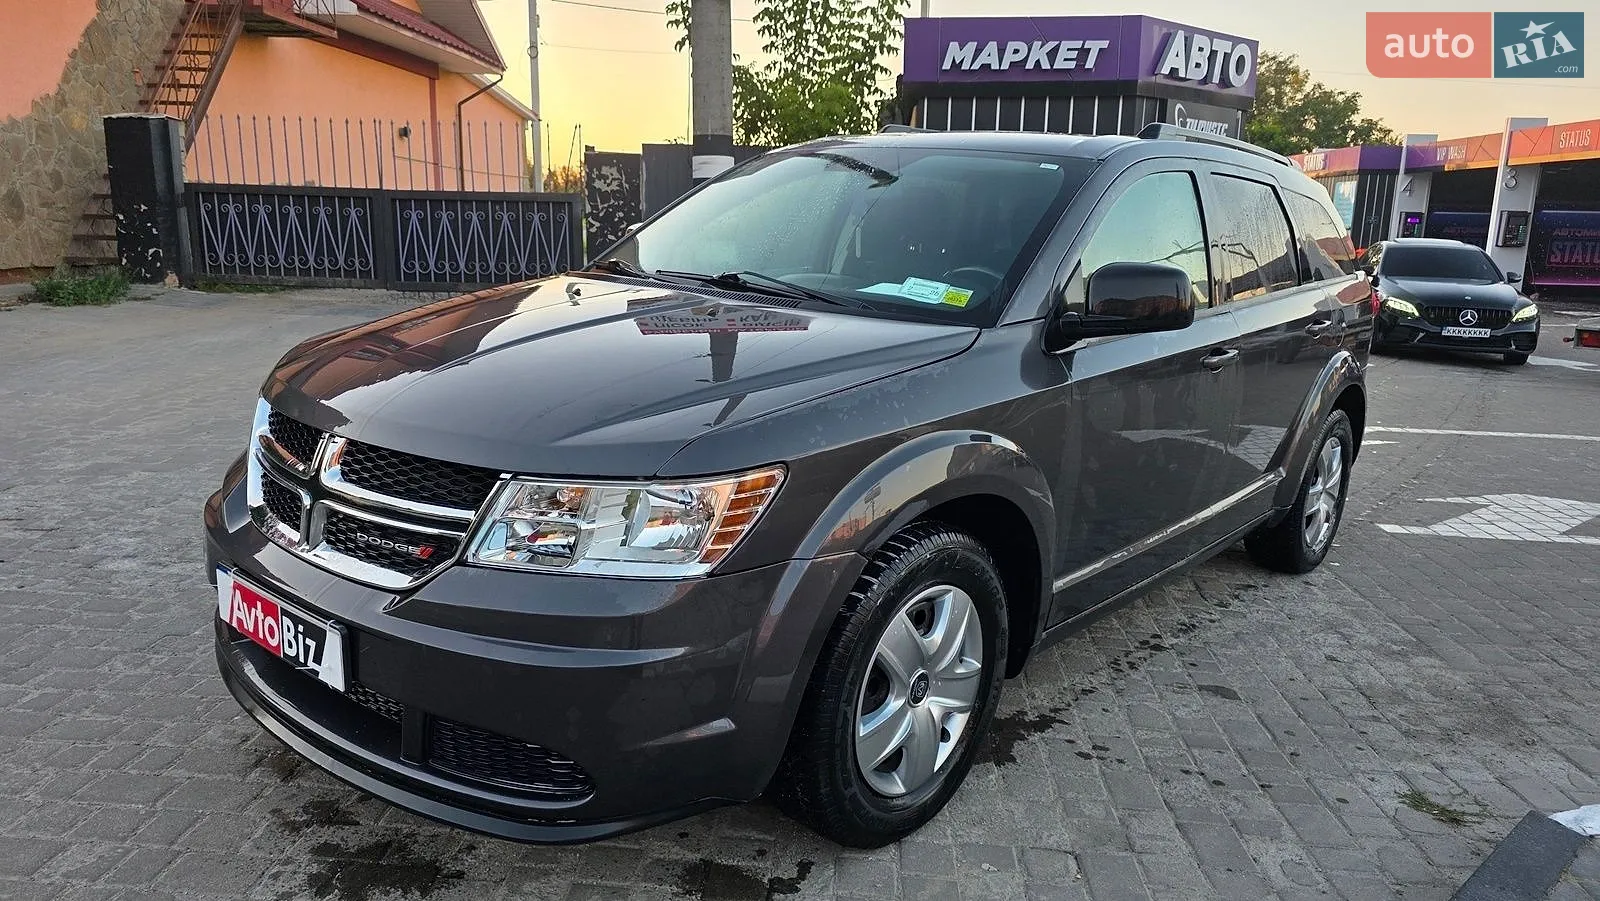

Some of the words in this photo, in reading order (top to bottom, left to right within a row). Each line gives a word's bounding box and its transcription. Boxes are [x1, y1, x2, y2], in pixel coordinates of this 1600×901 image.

[941, 40, 1110, 71] МАРКЕТ
[1160, 30, 1252, 88] АВТО
[1559, 128, 1591, 149] STATUS
[1401, 175, 1414, 197] 4
[1503, 168, 1518, 190] 3
[356, 532, 421, 555] DODGE
